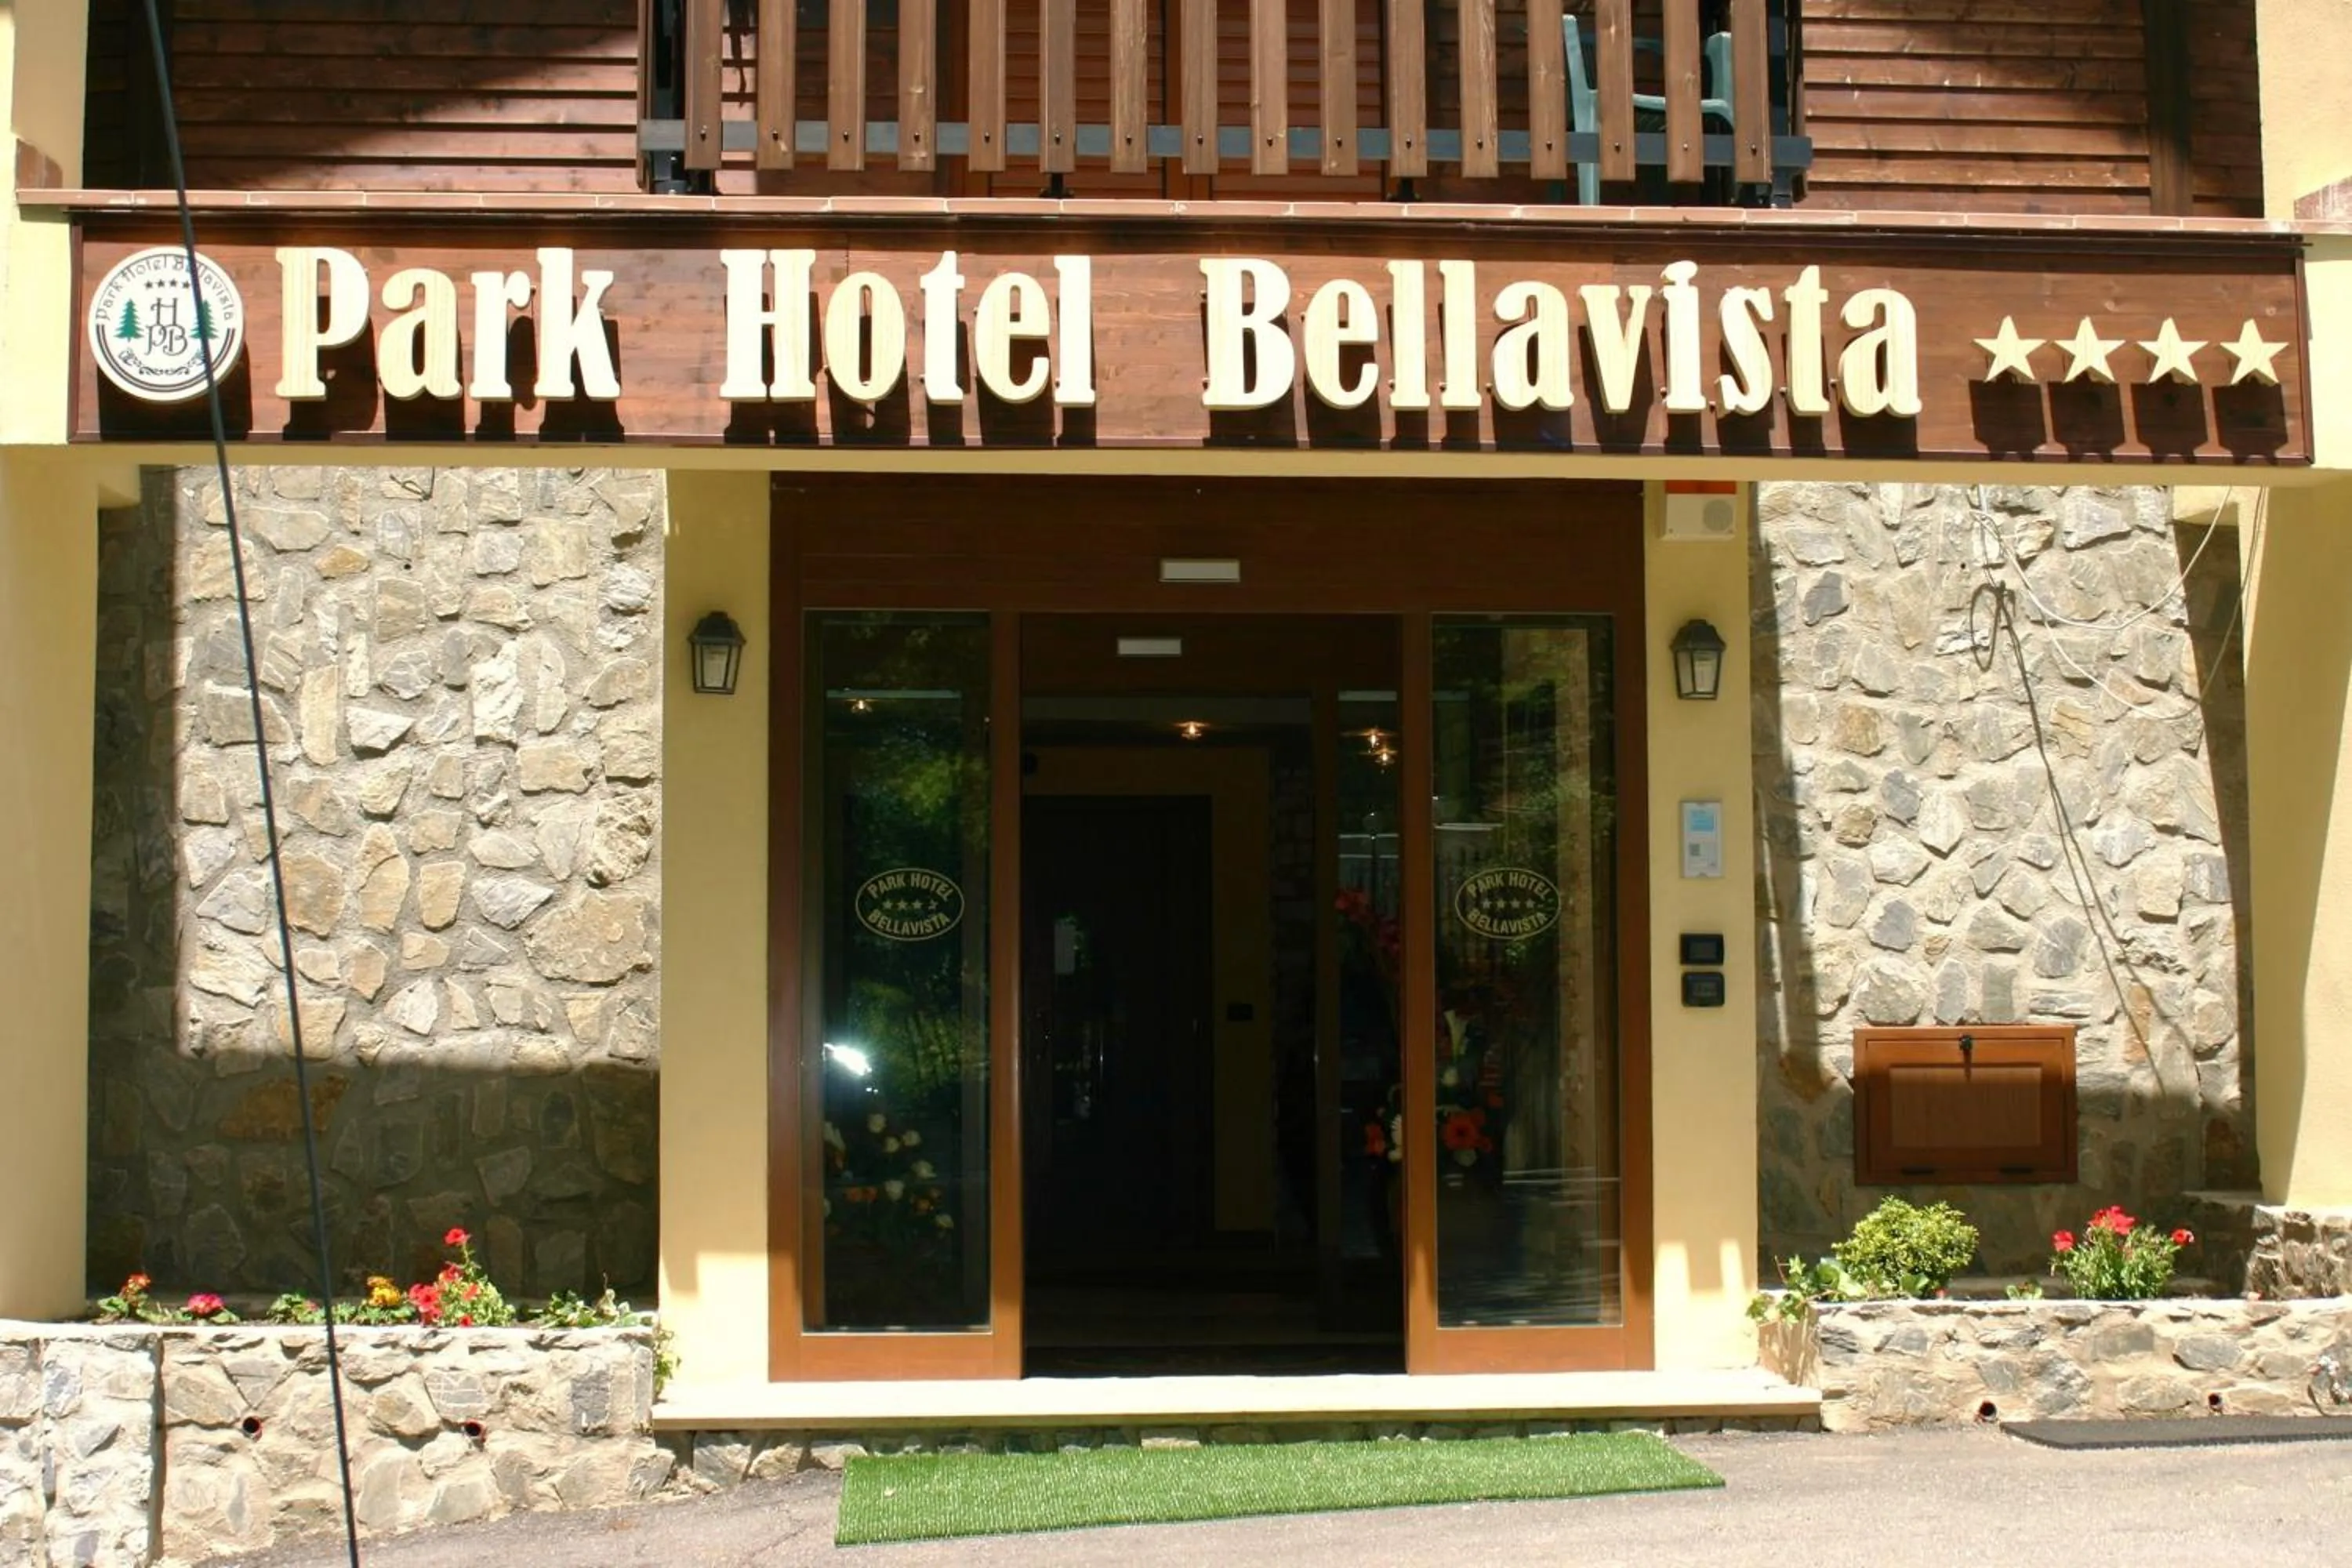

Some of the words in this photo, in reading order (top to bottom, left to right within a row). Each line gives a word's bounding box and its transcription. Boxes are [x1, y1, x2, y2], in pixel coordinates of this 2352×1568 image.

[172, 255, 234, 321] Blavista
[274, 246, 621, 398] Park
[719, 249, 1096, 404] Hotel
[1199, 257, 1922, 415] Bellavista
[867, 873, 906, 899] PARK
[910, 873, 954, 902] HOTEL
[1467, 872, 1504, 898] PARK
[1508, 872, 1552, 900] HOTEL
[867, 909, 951, 935] BELLAVISTA
[1467, 908, 1548, 935] BELLAVISTA
